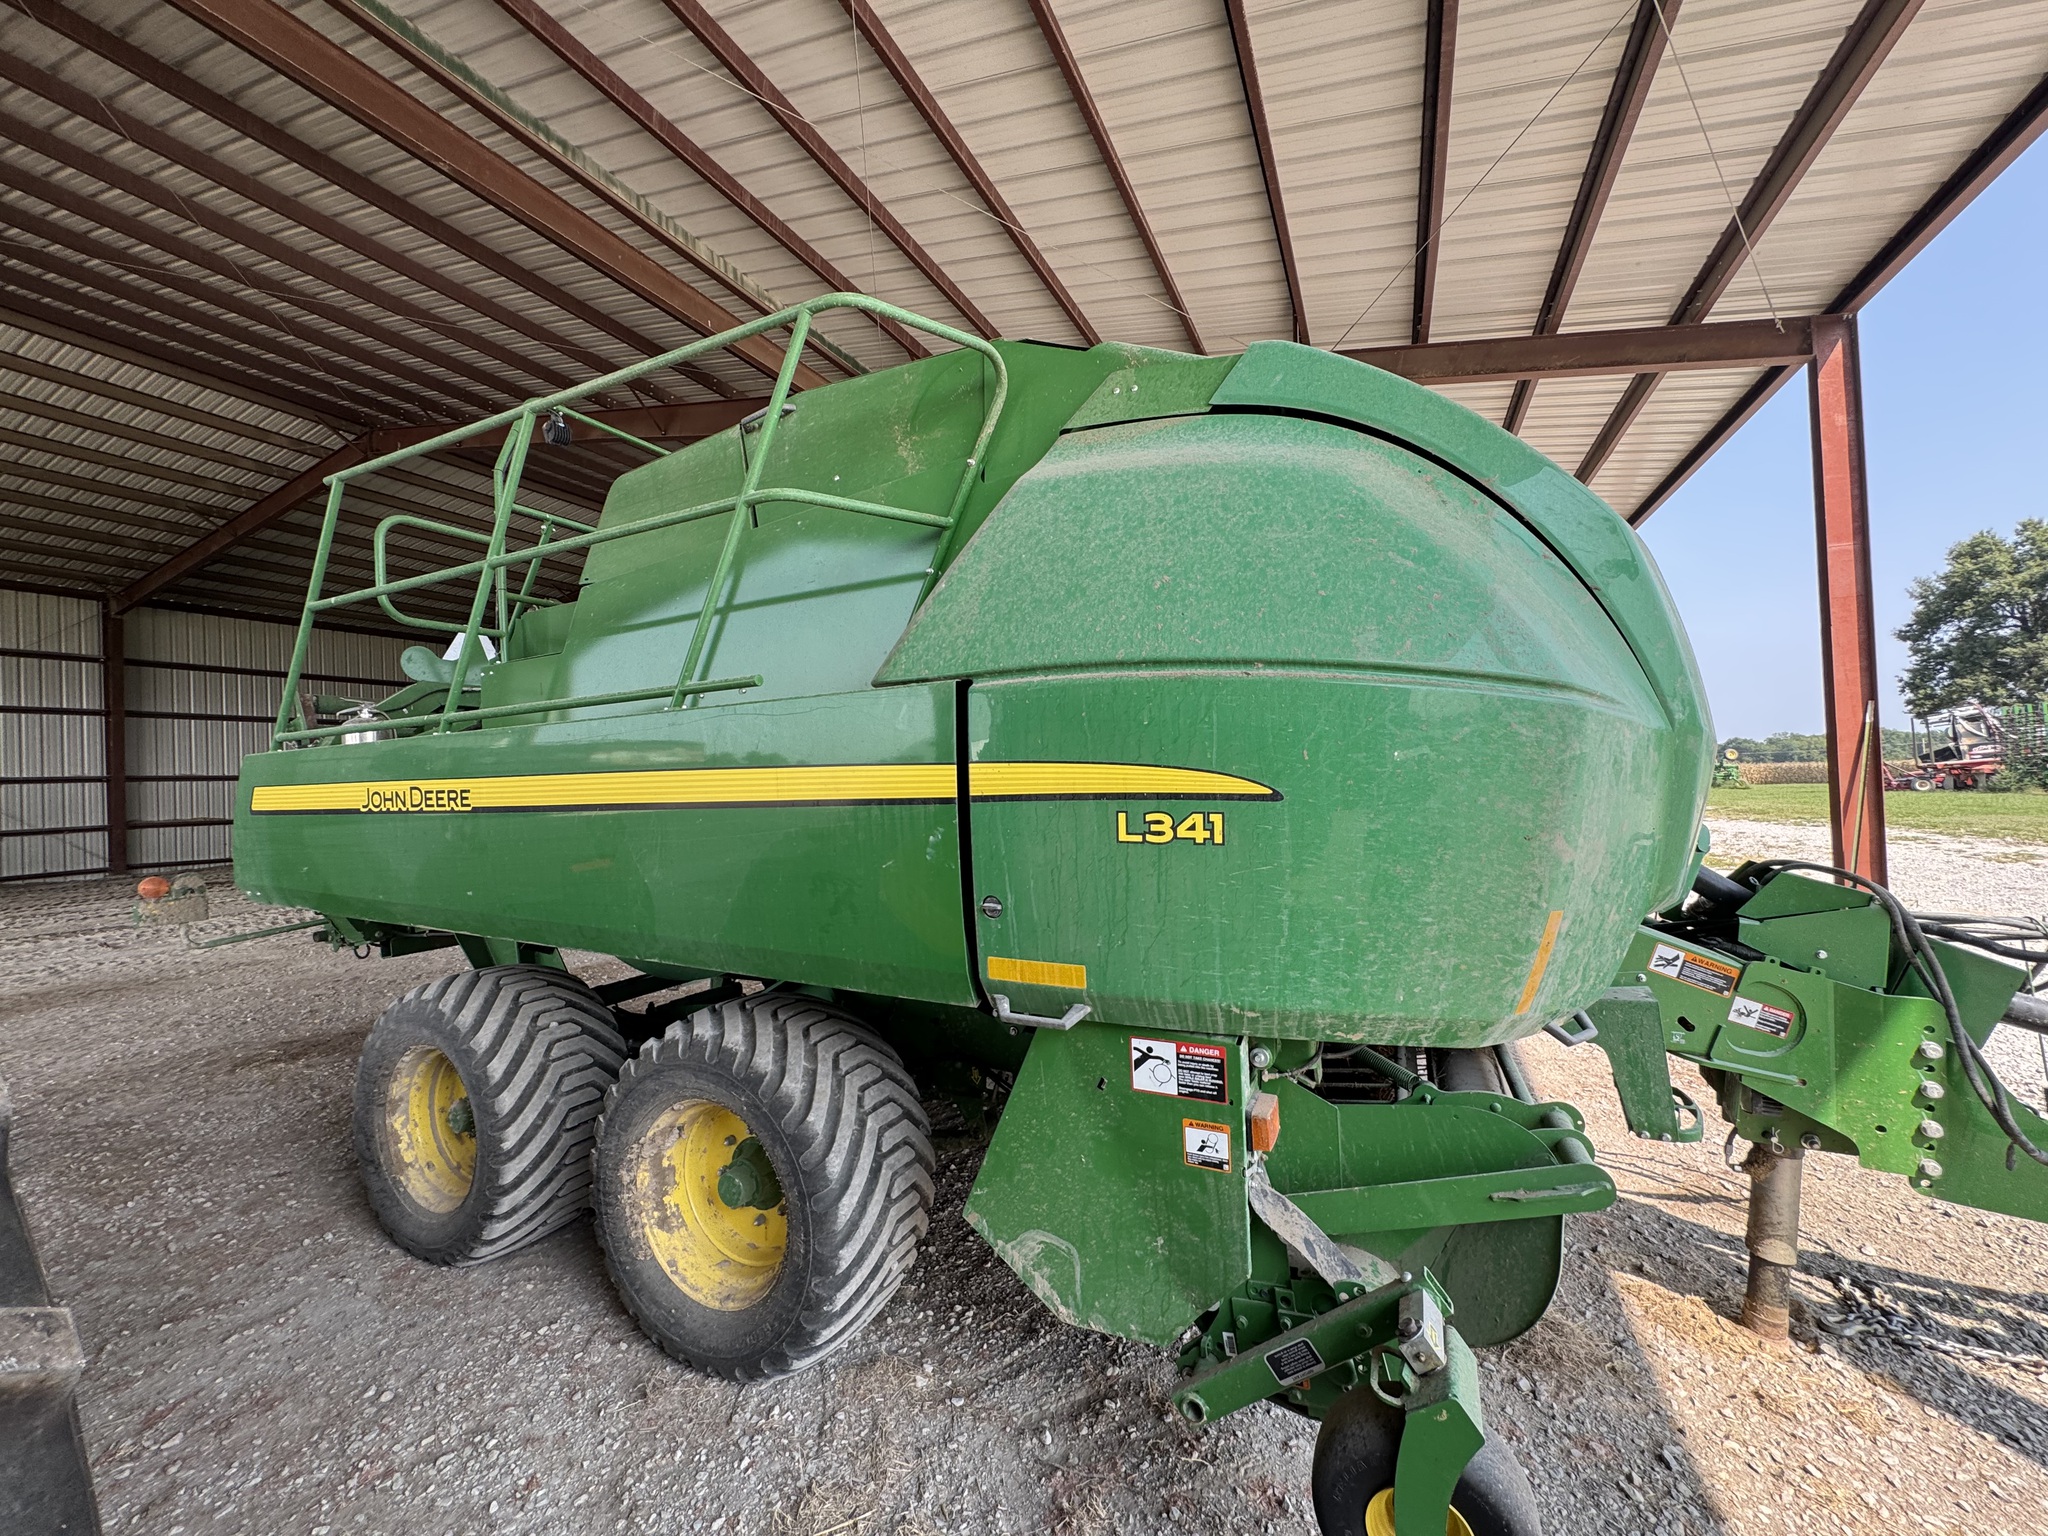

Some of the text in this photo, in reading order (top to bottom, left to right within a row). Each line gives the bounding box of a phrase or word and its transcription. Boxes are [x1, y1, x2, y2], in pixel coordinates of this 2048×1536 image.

[361, 786, 472, 809] JOHN DEERE
[1116, 810, 1225, 846] L341
[1697, 958, 1733, 974] WARNING
[1189, 1046, 1220, 1057] DANGER
[1195, 1121, 1224, 1132] WARNING
